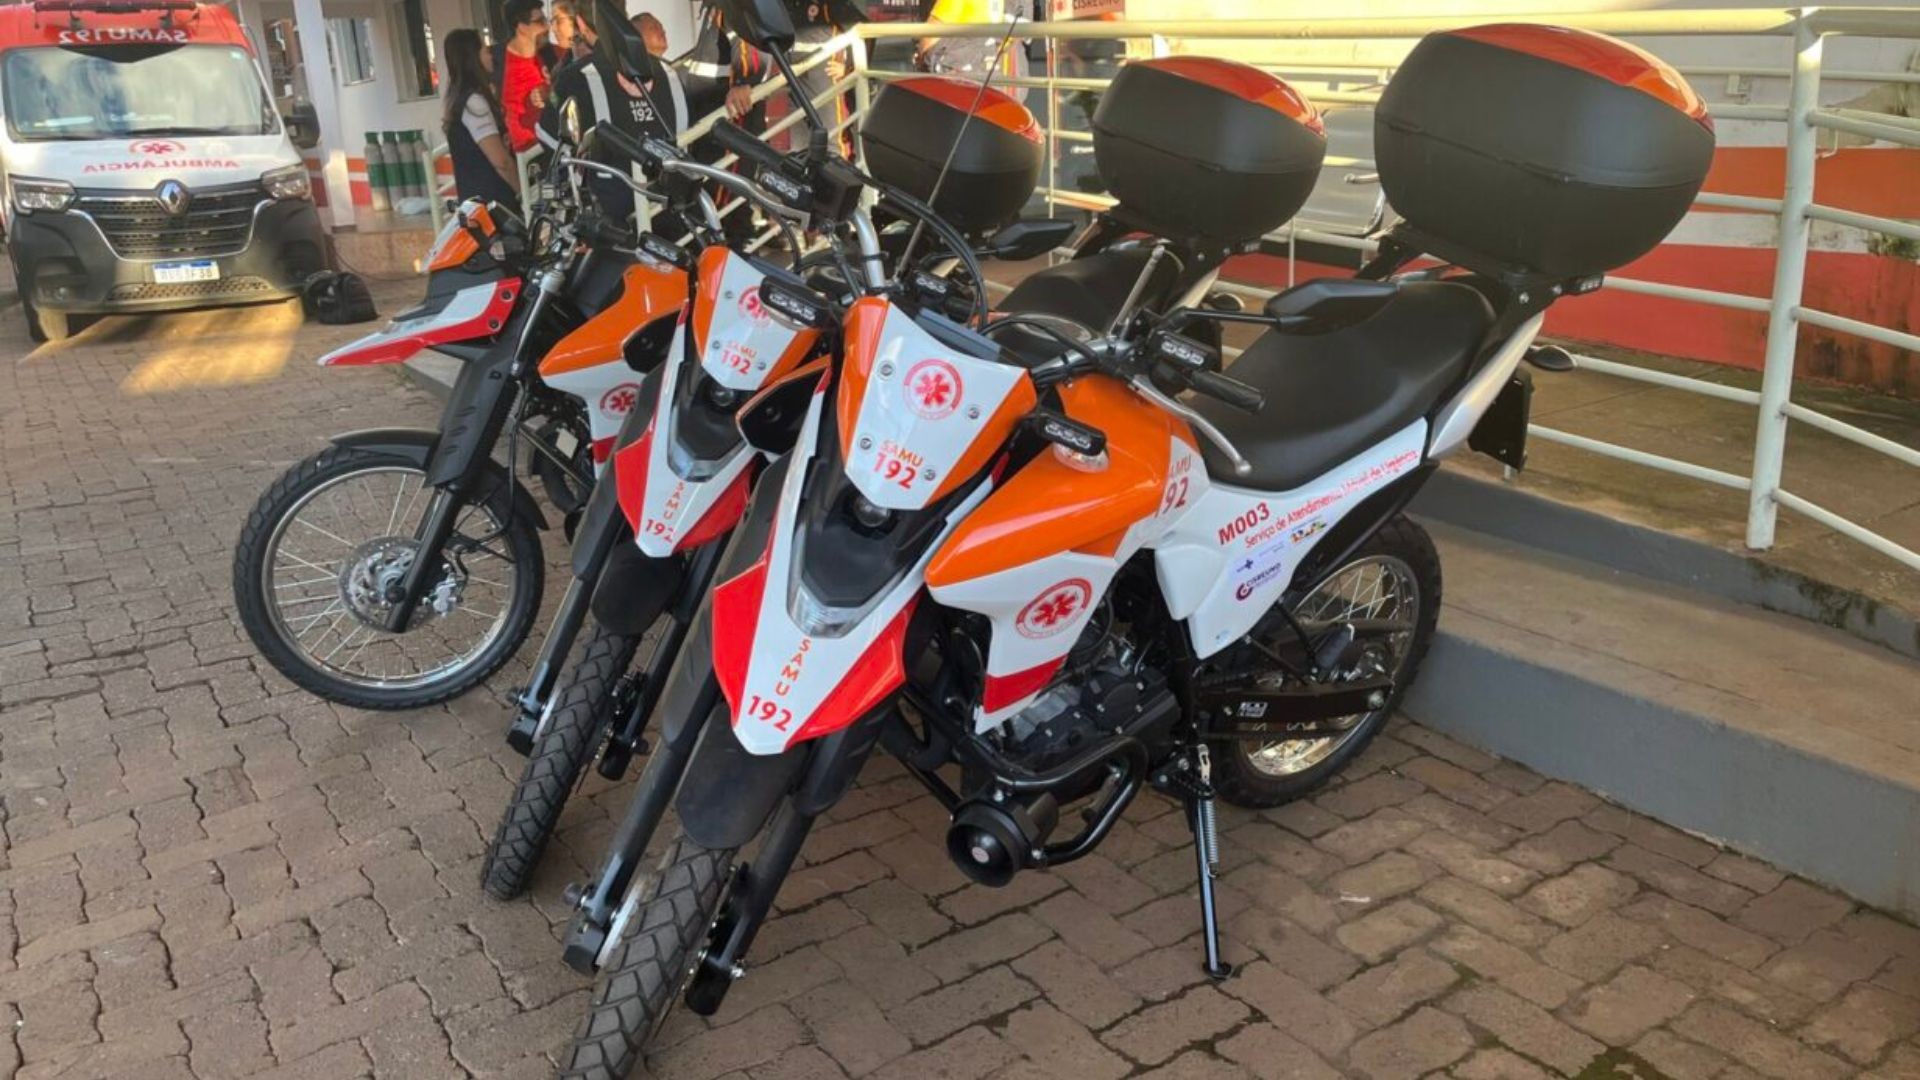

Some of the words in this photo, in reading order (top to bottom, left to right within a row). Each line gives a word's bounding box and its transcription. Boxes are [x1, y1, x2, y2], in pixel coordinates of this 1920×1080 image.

[632, 107, 655, 121] 192
[721, 349, 751, 374] 192
[726, 340, 757, 358] SAMU
[874, 451, 916, 489] 192
[881, 440, 922, 466] SAMU
[664, 481, 685, 519] SAMU
[1218, 502, 1270, 545] M003
[774, 638, 811, 696] SAMU
[747, 695, 793, 732] 192
